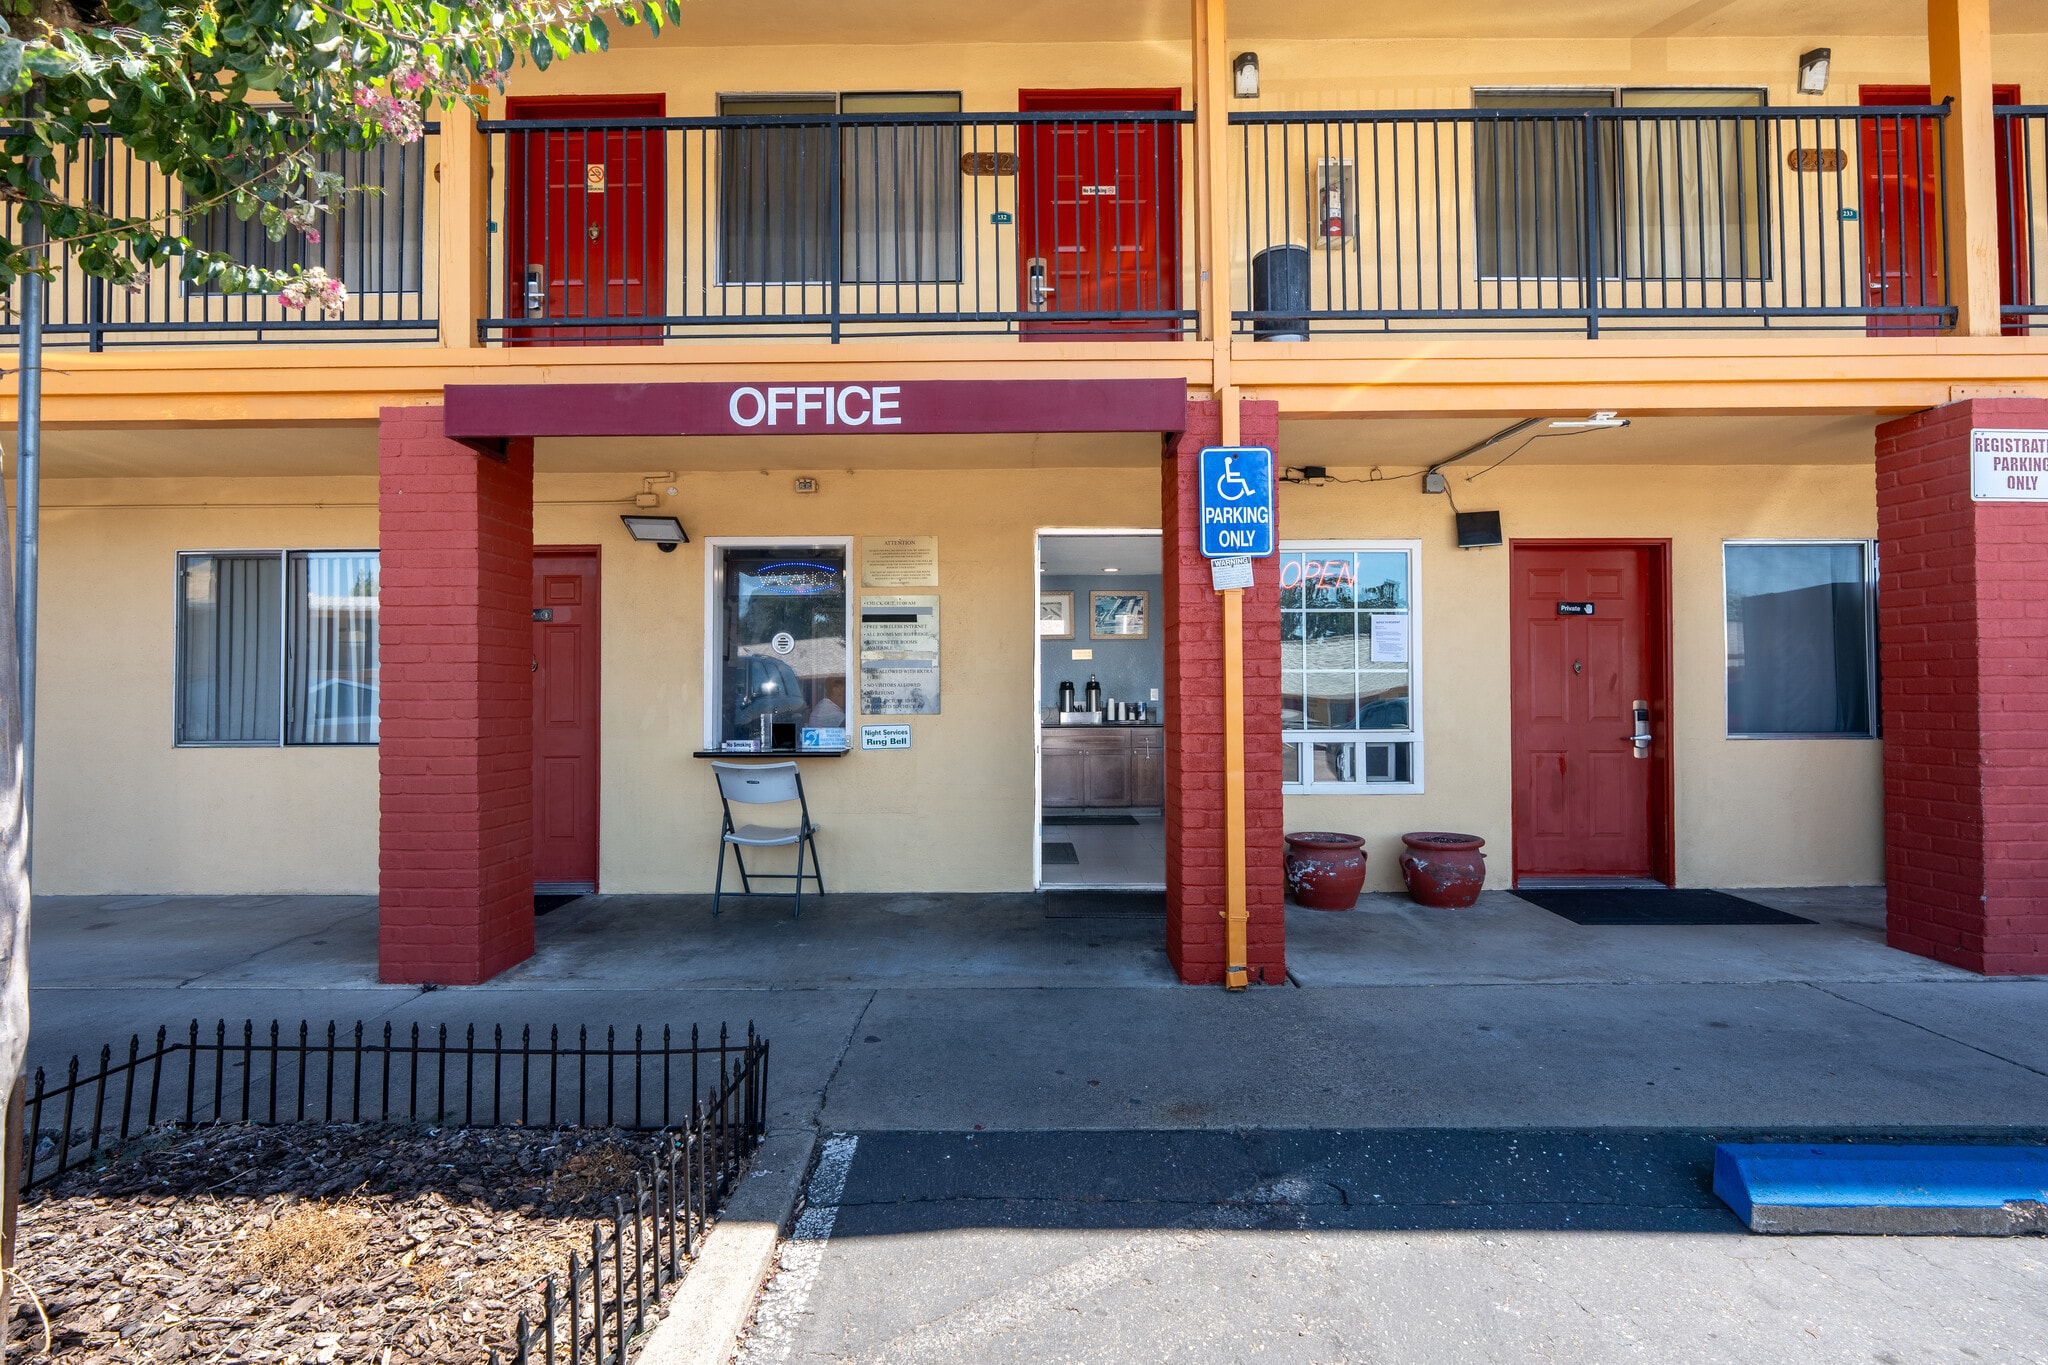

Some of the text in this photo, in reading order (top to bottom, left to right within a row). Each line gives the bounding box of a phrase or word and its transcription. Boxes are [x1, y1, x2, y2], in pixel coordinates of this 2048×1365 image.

[729, 386, 902, 427] OFFICE
[1975, 437, 2048, 453] REGISTRAT
[1993, 456, 2048, 472] PARKING
[2007, 475, 2039, 491] ONLY
[1205, 506, 1269, 524] PARKING
[1218, 529, 1256, 548] ONLY
[1214, 556, 1248, 567] WARNING
[757, 571, 837, 586] VACANCY
[1281, 560, 1361, 590] OPEN
[1560, 604, 1581, 612] Private
[864, 729, 882, 737] Night
[733, 741, 752, 749] Smoking
[866, 737, 907, 747] Ring Bell
